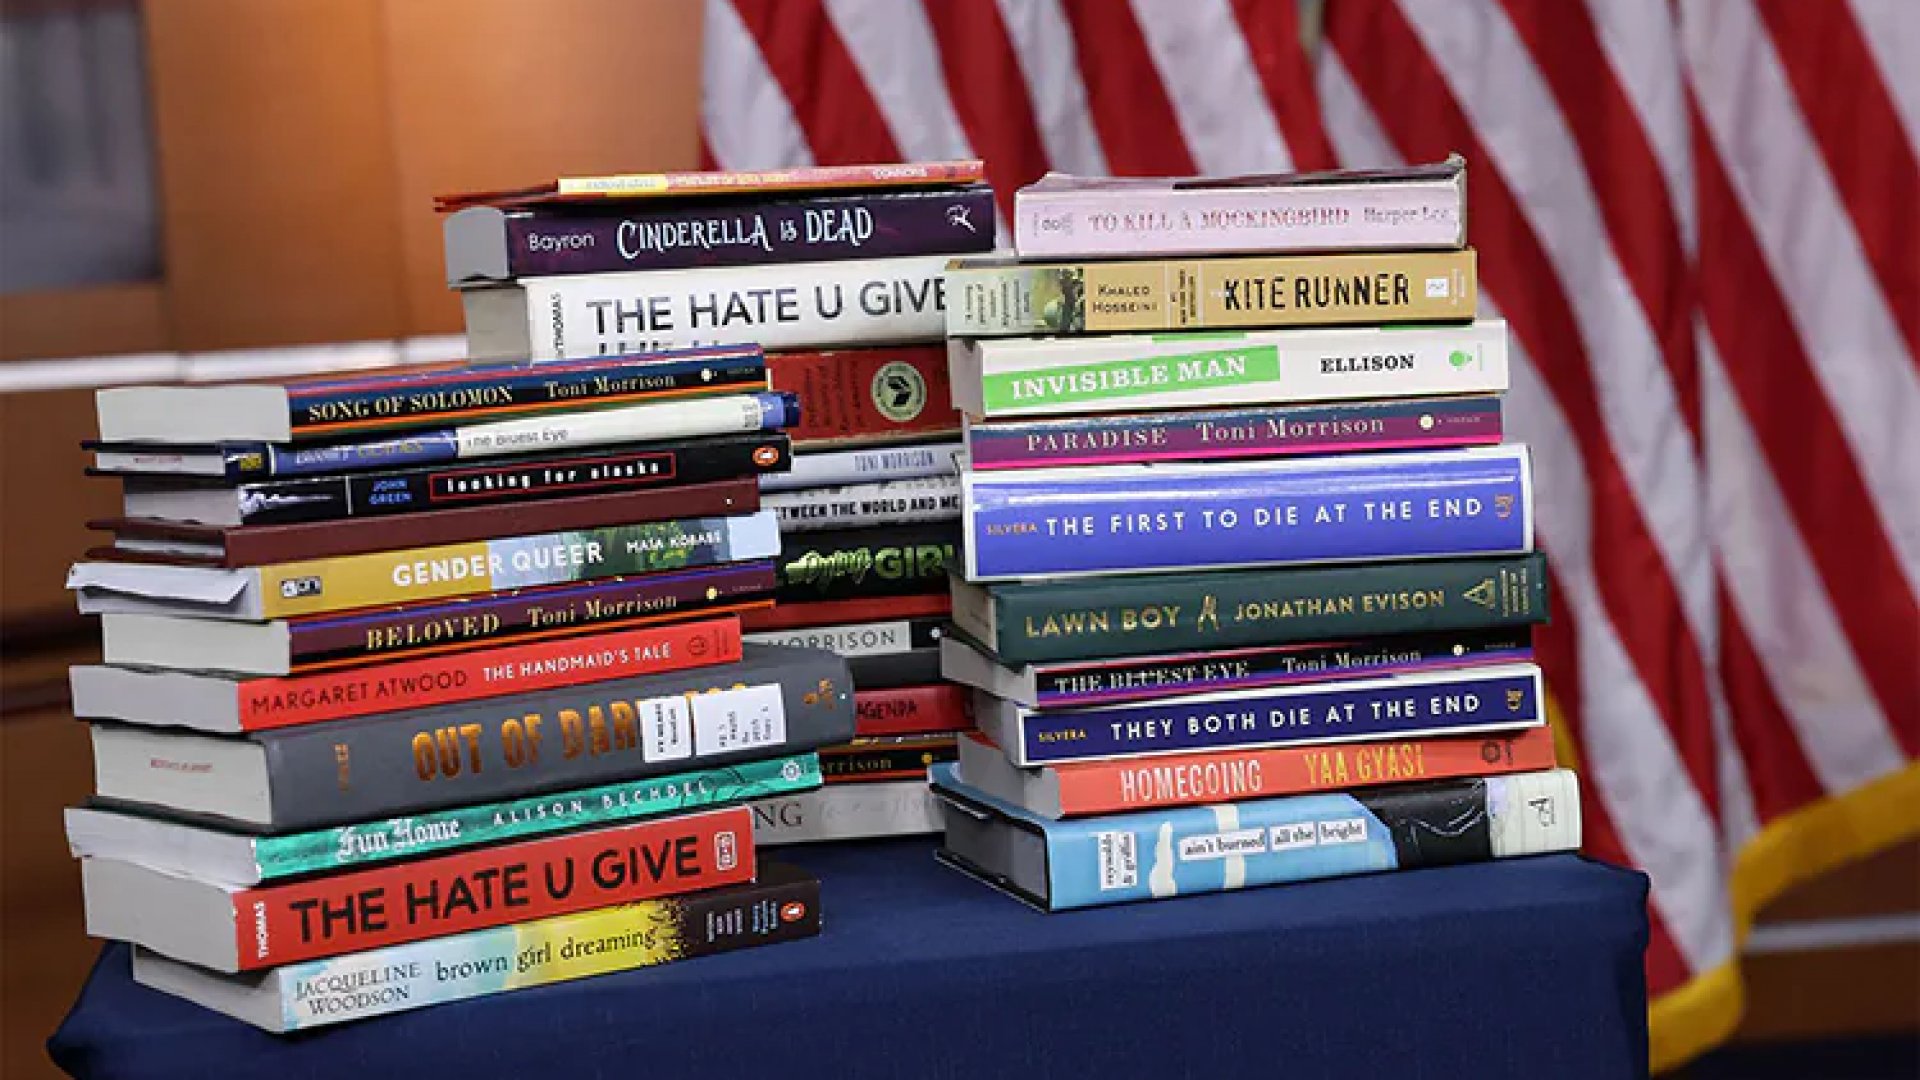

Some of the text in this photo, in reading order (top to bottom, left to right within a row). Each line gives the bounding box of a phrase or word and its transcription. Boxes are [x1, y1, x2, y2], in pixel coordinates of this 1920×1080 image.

[617, 214, 773, 259] CINDERELLA
[805, 207, 873, 244] DEAD
[1087, 213, 1117, 232] TO
[1123, 210, 1173, 232] KILL
[1180, 210, 1191, 230] A
[1200, 206, 1349, 230] MOCKINGBIRD
[528, 231, 595, 252] Bayron
[586, 296, 674, 334] THE
[689, 288, 800, 328] HATE
[816, 285, 842, 320] U
[859, 277, 946, 317] GIVE
[1093, 302, 1158, 313] HOSSEINI
[1098, 284, 1150, 297] KHALED
[1225, 276, 1286, 311] KITE
[1295, 273, 1410, 308] RUNNER
[1011, 354, 1248, 400] INVISIBLE MAN
[1320, 353, 1415, 375] ELLISON
[309, 384, 514, 423] SONG OF SOLOMON
[545, 375, 676, 399] Toni Morrison
[1027, 426, 1168, 452] PARADISE
[1195, 415, 1385, 443] Toni Morrison
[373, 479, 408, 491] JOHN
[447, 460, 659, 492] looking for alaska
[369, 491, 412, 505] GREEN
[774, 503, 827, 520] TWEEN
[831, 502, 856, 516] THE
[862, 498, 906, 515] WORLD
[911, 496, 937, 510] AND
[1046, 497, 1483, 536] THE FIRST TO DIE AT THE END
[392, 541, 605, 588] GENDER QUEER
[527, 593, 678, 629] Toni Morrison
[1025, 605, 1181, 639] LAWN BOY
[1234, 589, 1446, 623] JONATHAN EVISON
[366, 612, 502, 651] BELOVED
[483, 662, 514, 682] THE
[520, 648, 630, 679] HANDMAID'S
[634, 641, 672, 662] TALE
[1054, 660, 1250, 695] THE BLUEST EYE
[1282, 650, 1422, 674] Toni Morrison
[252, 669, 469, 716] MARGARET ATWOOD
[1110, 693, 1482, 741] THEY BOTH DIE AT THE END
[411, 722, 483, 783] OUT
[502, 713, 544, 769] OF
[1305, 743, 1425, 785] YAA GYASI
[1120, 758, 1263, 803] HOMEGOING
[494, 781, 707, 826] ALISON BECHDEL
[337, 817, 462, 863] Fun Home
[289, 887, 389, 943] THE
[405, 863, 531, 925] HATE
[545, 857, 575, 900] U
[591, 836, 702, 890] GIVE
[254, 900, 270, 960] THOMAS
[435, 928, 657, 983] brown girl dreaming
[296, 961, 424, 1001] JACQUELINE
[308, 984, 410, 1016] WOODSON
